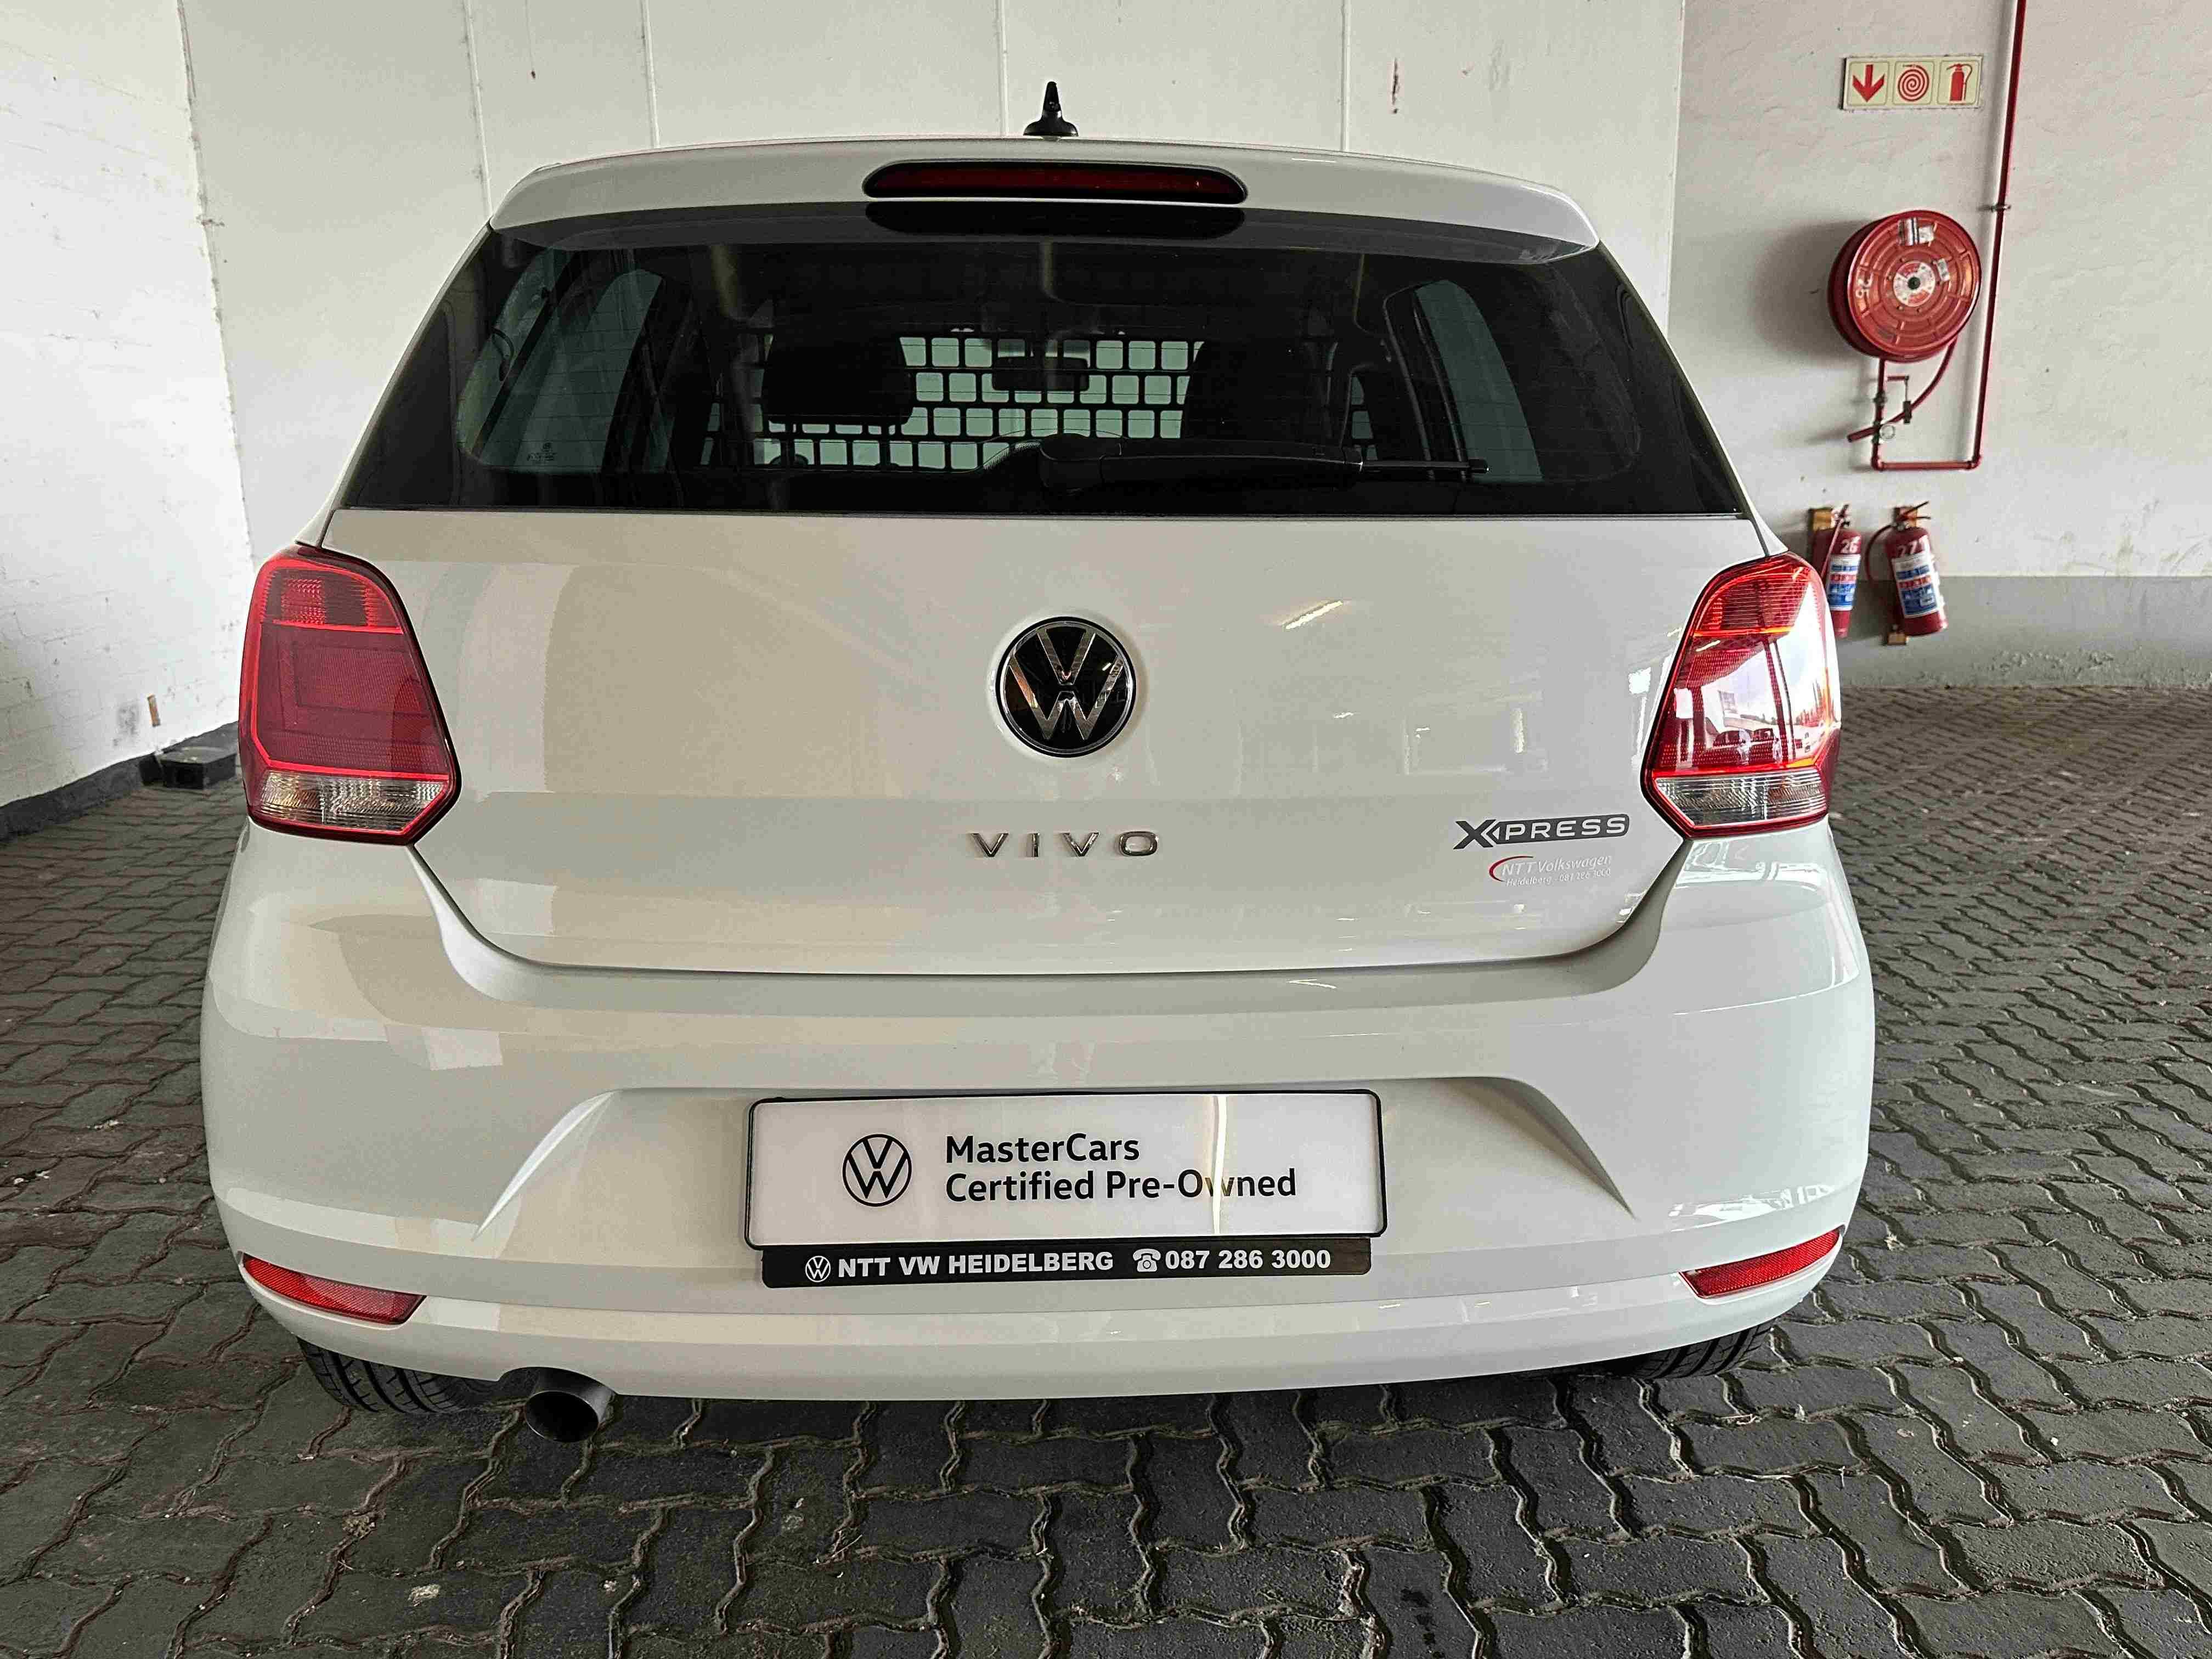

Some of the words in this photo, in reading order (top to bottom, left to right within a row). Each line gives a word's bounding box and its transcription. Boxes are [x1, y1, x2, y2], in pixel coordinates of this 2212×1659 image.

[970, 831, 1159, 857] VIVO
[1453, 815, 1628, 849] XPRESS
[1502, 861, 1536, 876] NTT
[1538, 856, 1612, 873] Volkswagen
[946, 1133, 1139, 1163] MasterCars
[946, 1170, 1094, 1201] Certified
[1107, 1168, 1296, 1198] Pre-Owned
[838, 1257, 890, 1277] NTT
[898, 1256, 940, 1275] VW
[949, 1251, 1113, 1273] HEIDELBERG
[1165, 1250, 1210, 1269] 087
[1218, 1250, 1263, 1268] 286
[1271, 1250, 1331, 1268] 3000
